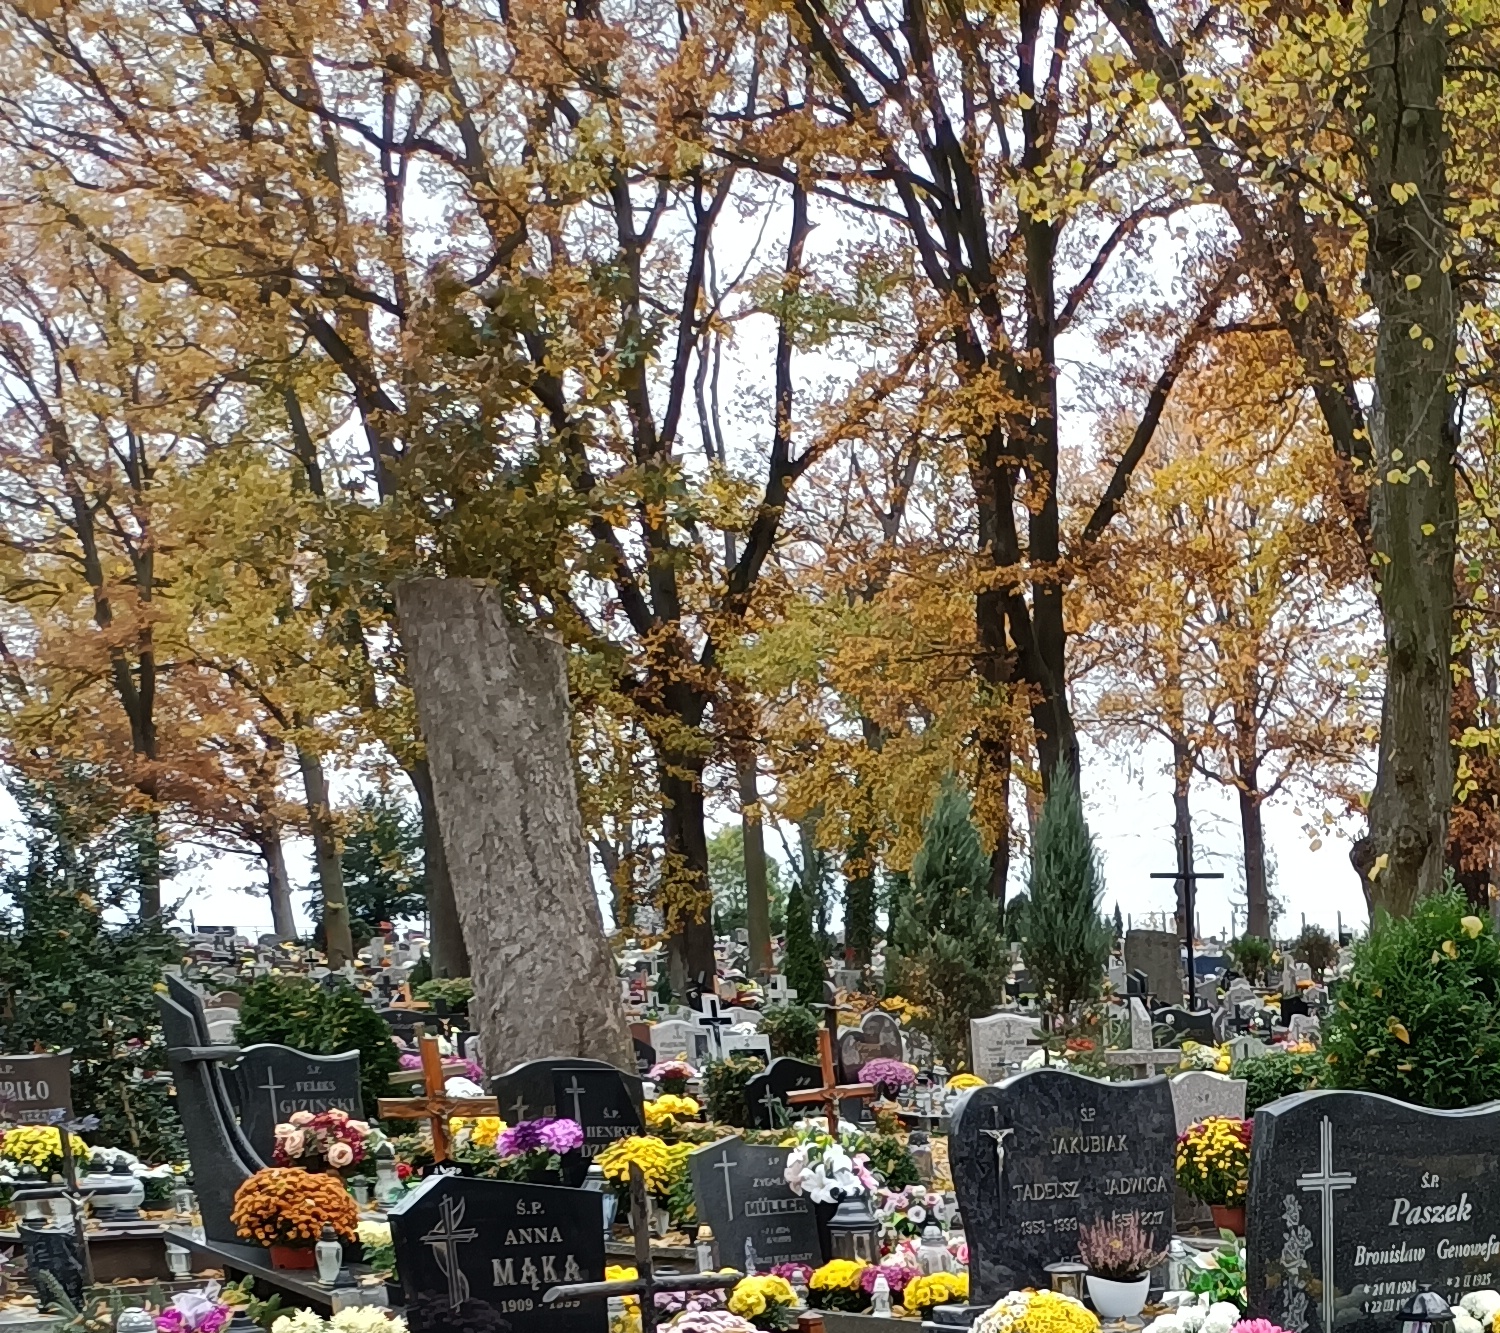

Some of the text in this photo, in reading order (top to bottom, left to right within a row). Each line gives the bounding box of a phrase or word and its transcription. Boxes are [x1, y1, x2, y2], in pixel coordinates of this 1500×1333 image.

[1050, 1134, 1129, 1155] JAKUBIAK
[1012, 1175, 1168, 1202] TADEUSZ JADWIGA
[516, 1198, 546, 1216] Ś.P.
[1388, 1192, 1473, 1226] Paszek
[504, 1226, 563, 1245] ANNA
[1354, 1234, 1500, 1266] Bronisław Genowefa
[491, 1254, 583, 1291] MĄKA
[501, 1297, 534, 1313] 1909
